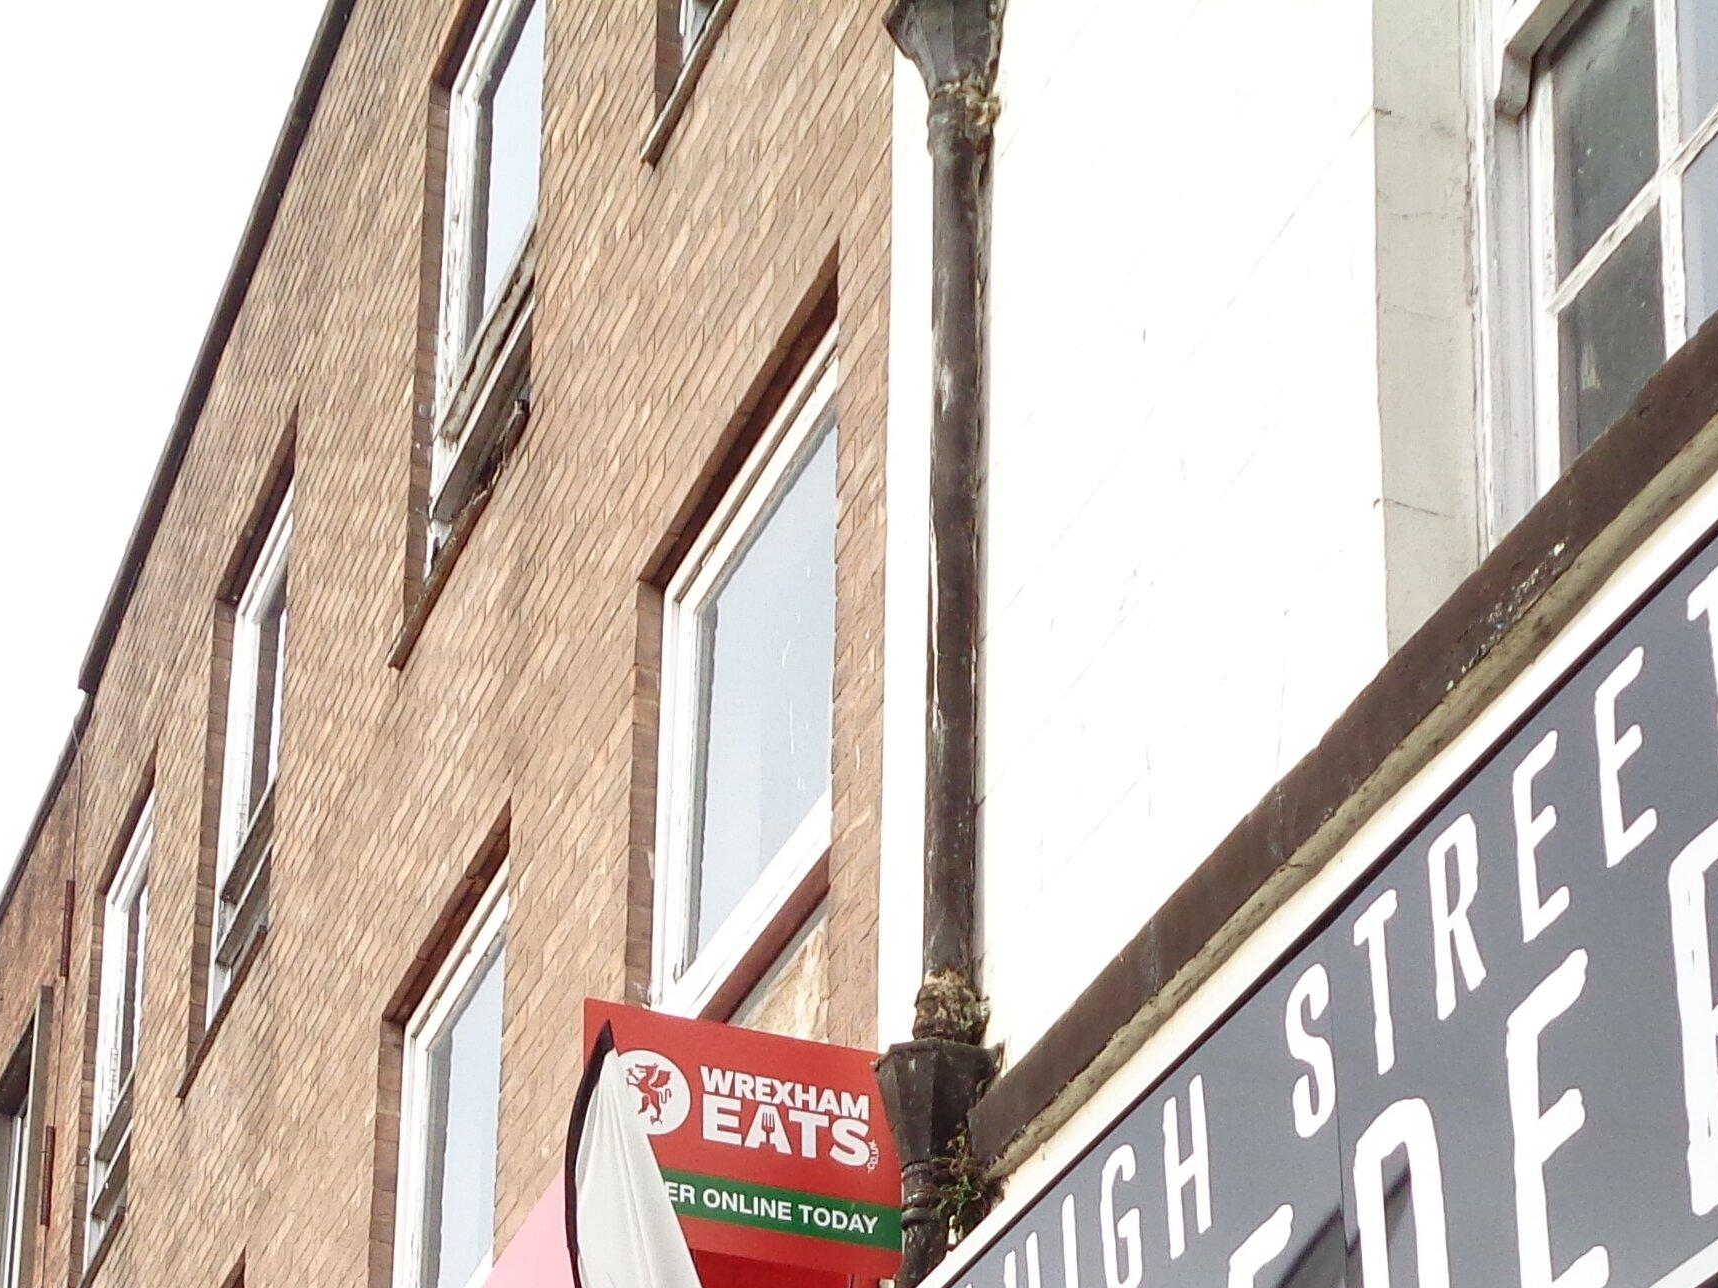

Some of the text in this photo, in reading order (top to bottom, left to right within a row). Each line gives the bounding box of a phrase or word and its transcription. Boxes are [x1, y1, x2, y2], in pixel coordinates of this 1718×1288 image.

[700, 1065, 869, 1120] WREXHAM
[703, 1094, 871, 1167] EATS
[703, 1189, 792, 1221] ONLINE
[798, 1205, 878, 1234] TODAY
